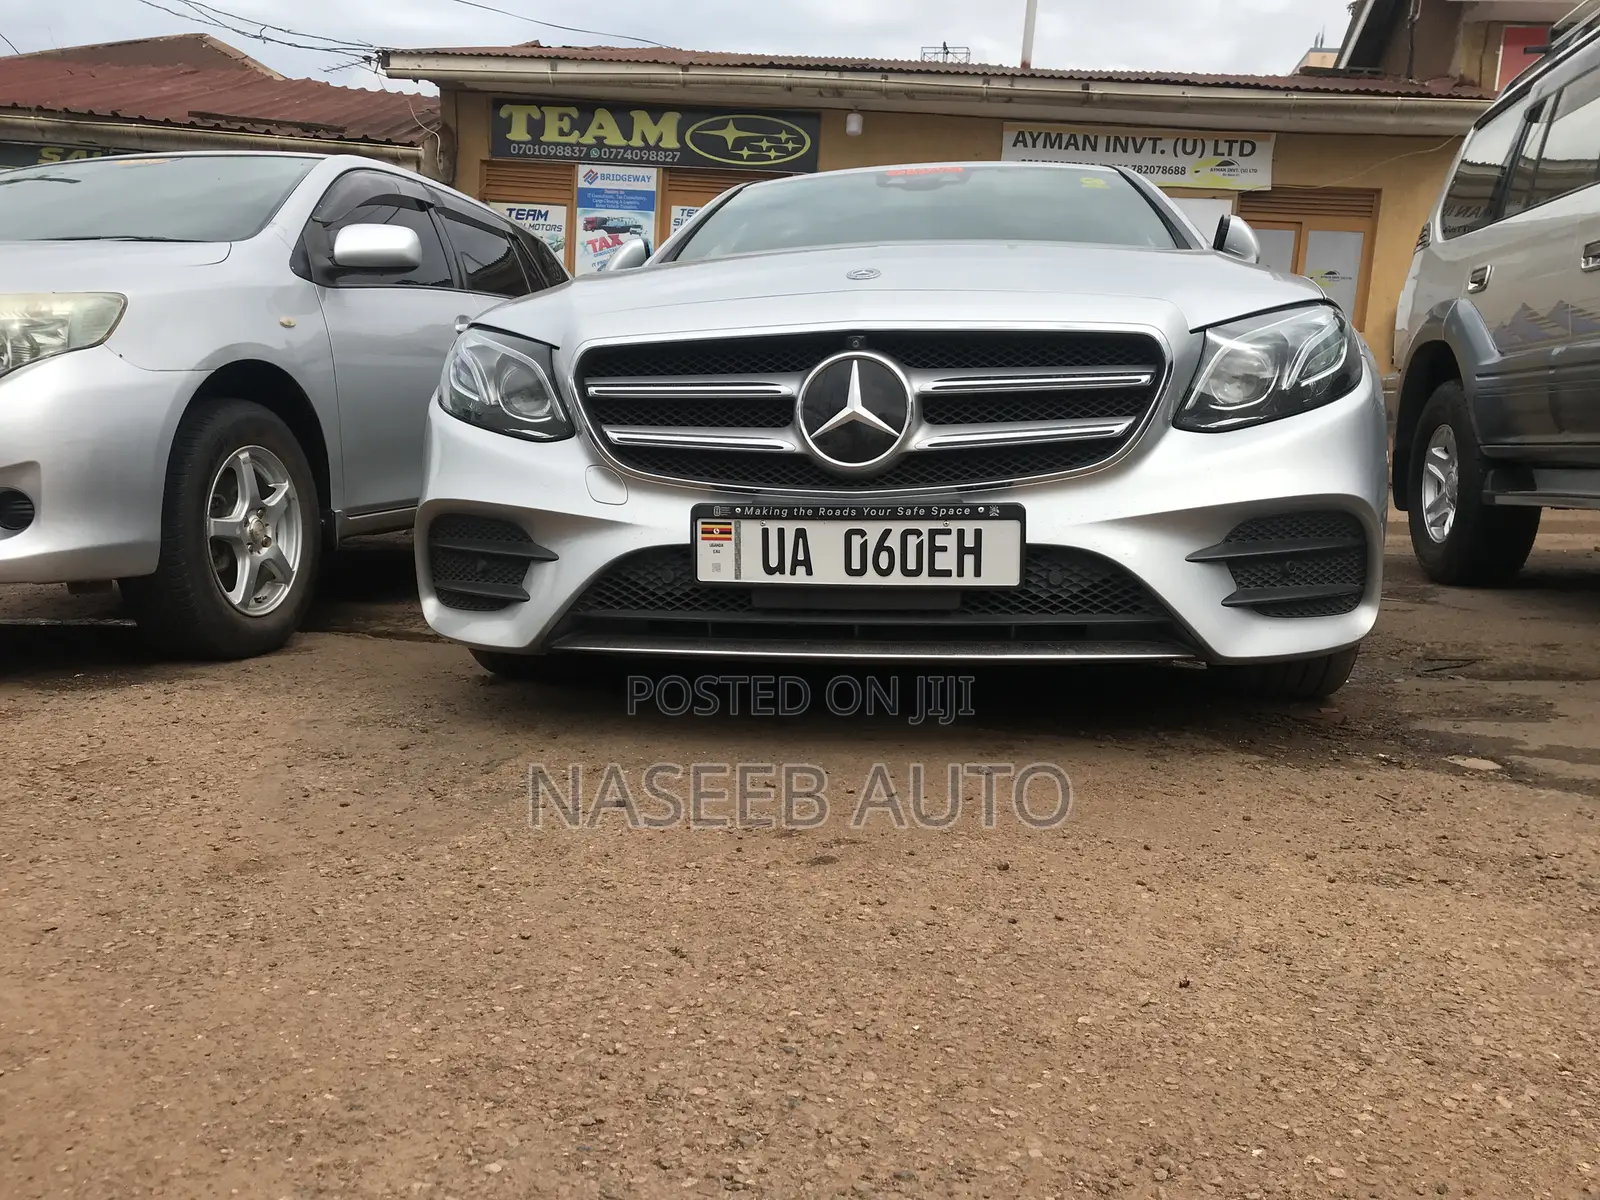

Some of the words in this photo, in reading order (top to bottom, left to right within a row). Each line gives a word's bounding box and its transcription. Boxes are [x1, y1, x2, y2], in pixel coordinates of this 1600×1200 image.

[500, 104, 682, 149] TEAM
[510, 143, 587, 158] 0701098837
[601, 147, 680, 162] 0774098827
[1012, 130, 1099, 152] AYMAN
[1105, 135, 1165, 155] INVT.
[1173, 138, 1206, 158] (U)
[1213, 139, 1257, 157] LTD
[600, 173, 652, 183] BRIDGEWAY
[506, 208, 549, 221] TEAM
[529, 223, 563, 232] MOTORS
[586, 234, 624, 254] TAX
[744, 506, 788, 518] Making
[793, 507, 813, 516] the
[819, 507, 857, 516] Roads
[863, 507, 891, 516] Your
[897, 506, 926, 516] Safe
[931, 506, 971, 517] Space
[761, 527, 813, 576] UA
[844, 527, 983, 577] 060EH
